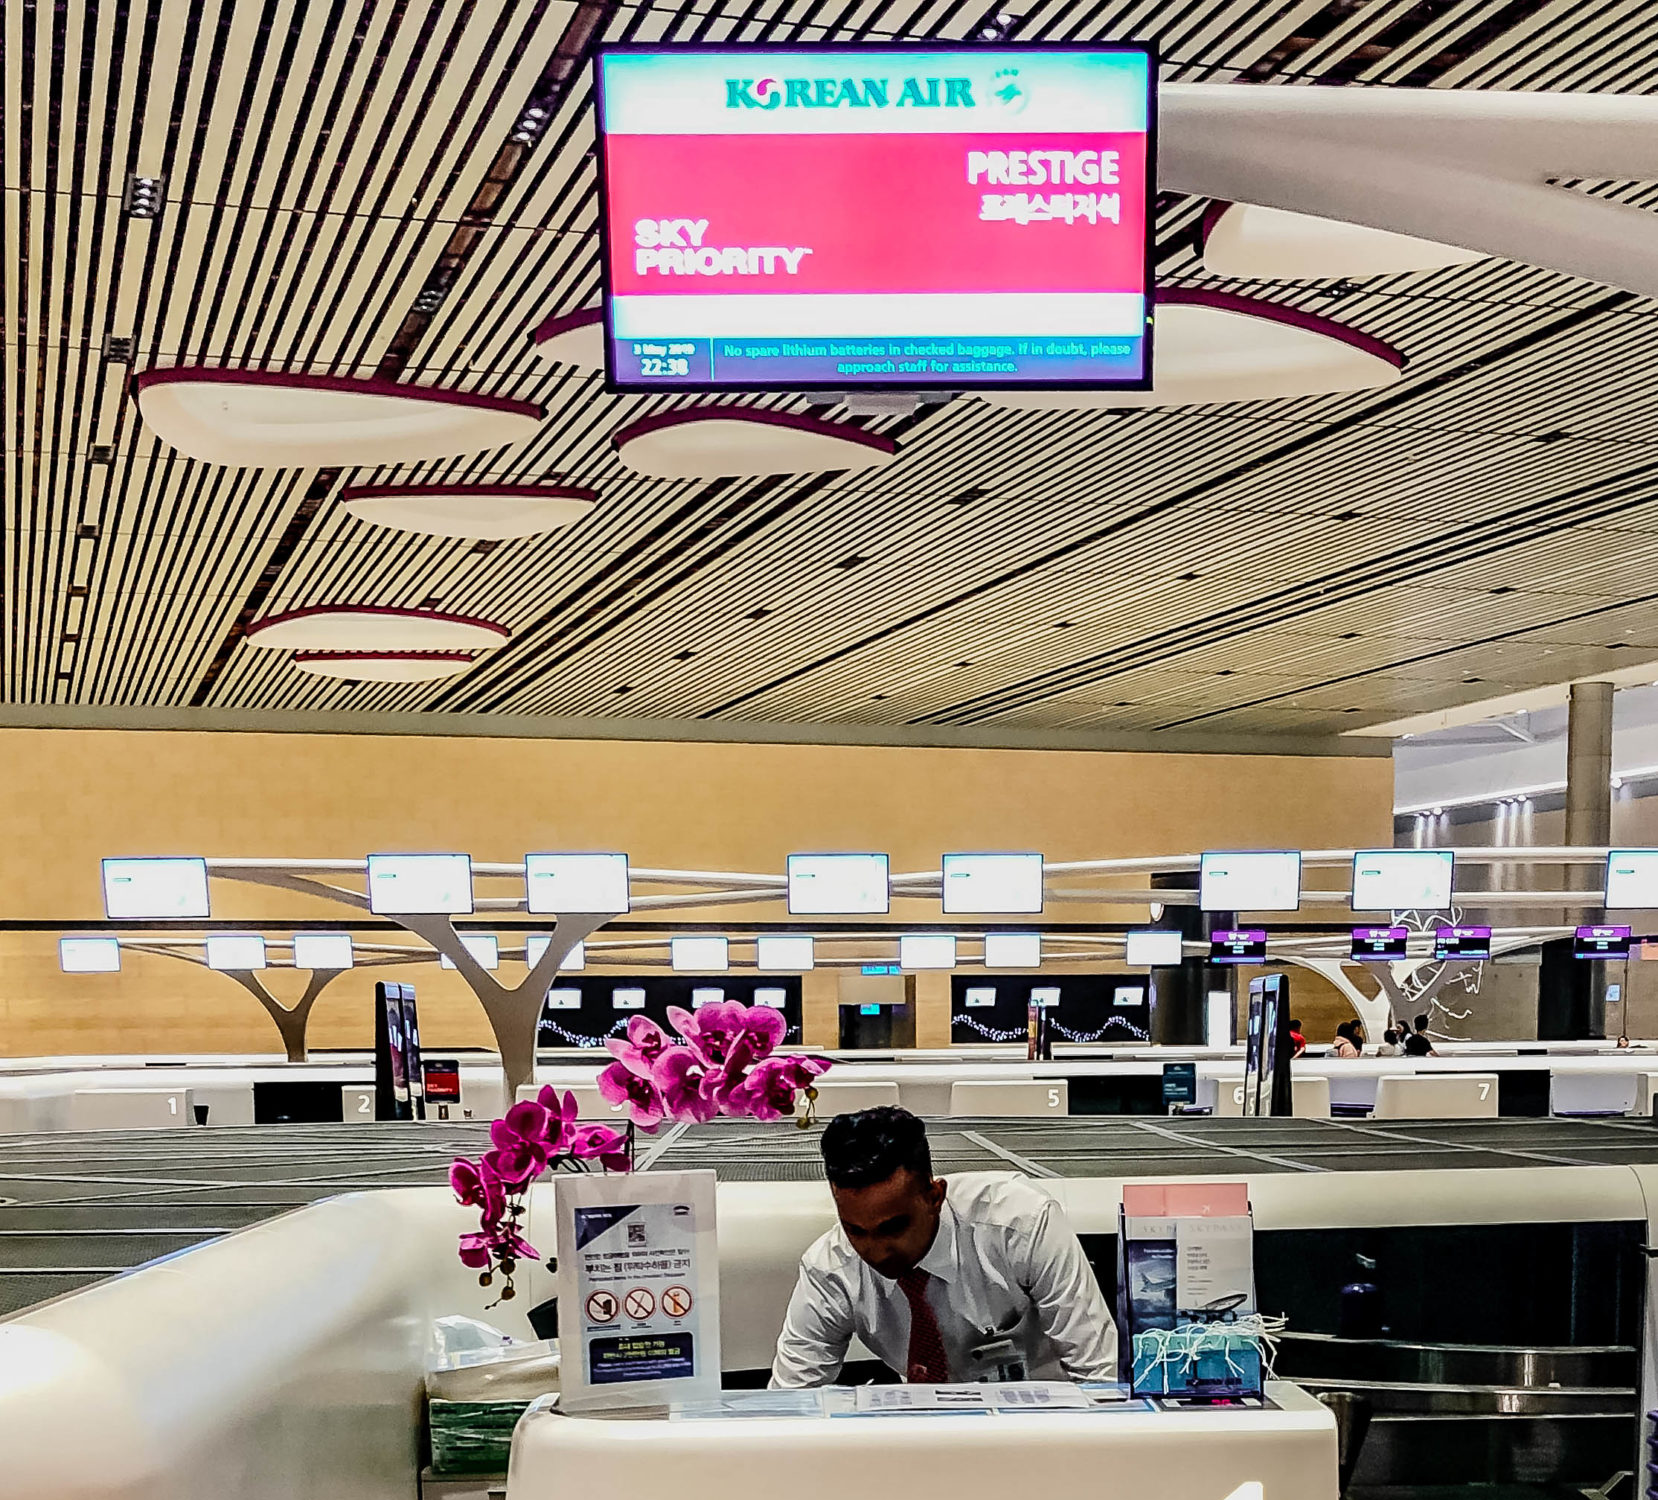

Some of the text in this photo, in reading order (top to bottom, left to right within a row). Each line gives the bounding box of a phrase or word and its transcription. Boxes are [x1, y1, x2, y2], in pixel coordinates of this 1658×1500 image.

[725, 77, 976, 110] KOREAN AIR
[968, 151, 1120, 185] PRESTIGE
[635, 219, 709, 247] SKY
[724, 342, 1131, 360] No spare lithium batteries in checked baggage. If in doubt, please
[837, 360, 1018, 376] approach staff for assistance.
[1048, 1089, 1059, 1107] 5
[1478, 1083, 1490, 1101] 7
[168, 1098, 177, 1115] 1
[358, 1096, 370, 1113] 2
